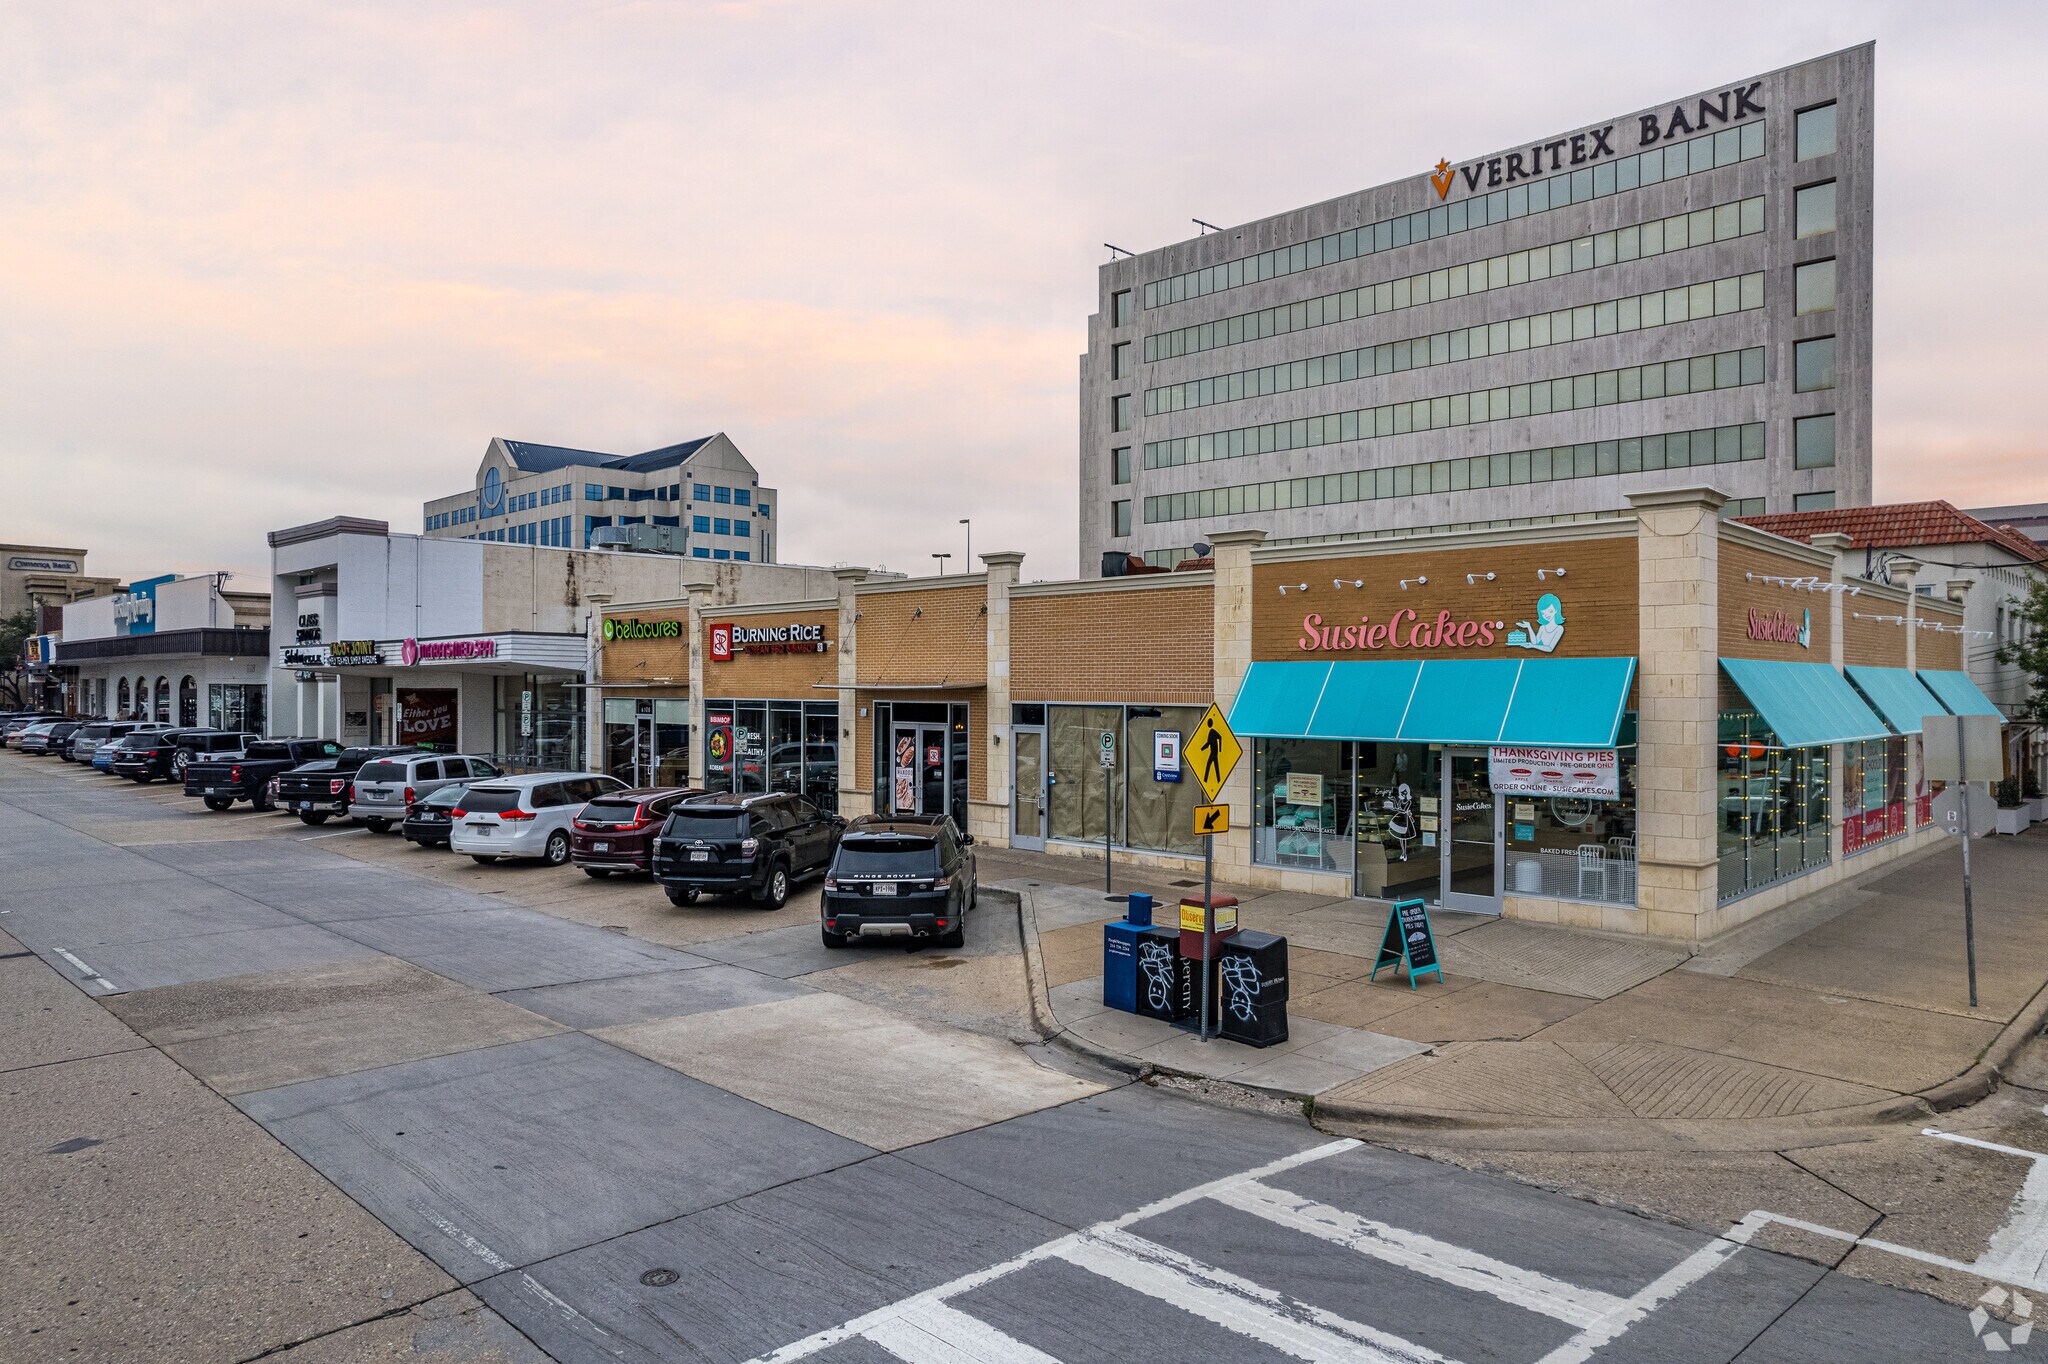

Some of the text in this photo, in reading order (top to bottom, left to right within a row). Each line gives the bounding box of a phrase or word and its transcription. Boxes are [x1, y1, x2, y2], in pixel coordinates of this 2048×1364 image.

[1460, 81, 1766, 192] VERITEX BANK
[298, 613, 319, 628] CLASS
[1747, 606, 1798, 643] SusieCakes
[615, 619, 680, 639] bellacures
[732, 623, 821, 643] BURNING RICE
[1299, 608, 1497, 651] SusieCakes
[352, 640, 374, 656] JOINT
[403, 704, 448, 718] Either you
[402, 715, 452, 733] LOVE
[747, 732, 762, 741] RESH.
[1104, 736, 1112, 746] P
[747, 748, 766, 756] ALTHY.
[1492, 747, 1614, 762] THANKSGIVING PIES
[1517, 759, 1556, 767] PRODUCTION
[1552, 786, 1614, 795] SUSIECAKES.COM
[1456, 802, 1492, 811] SusieCakes
[1540, 847, 1600, 858] BAKED FRESH DAILY
[1181, 908, 1206, 924] Observe
[1180, 957, 1191, 1010] percity
